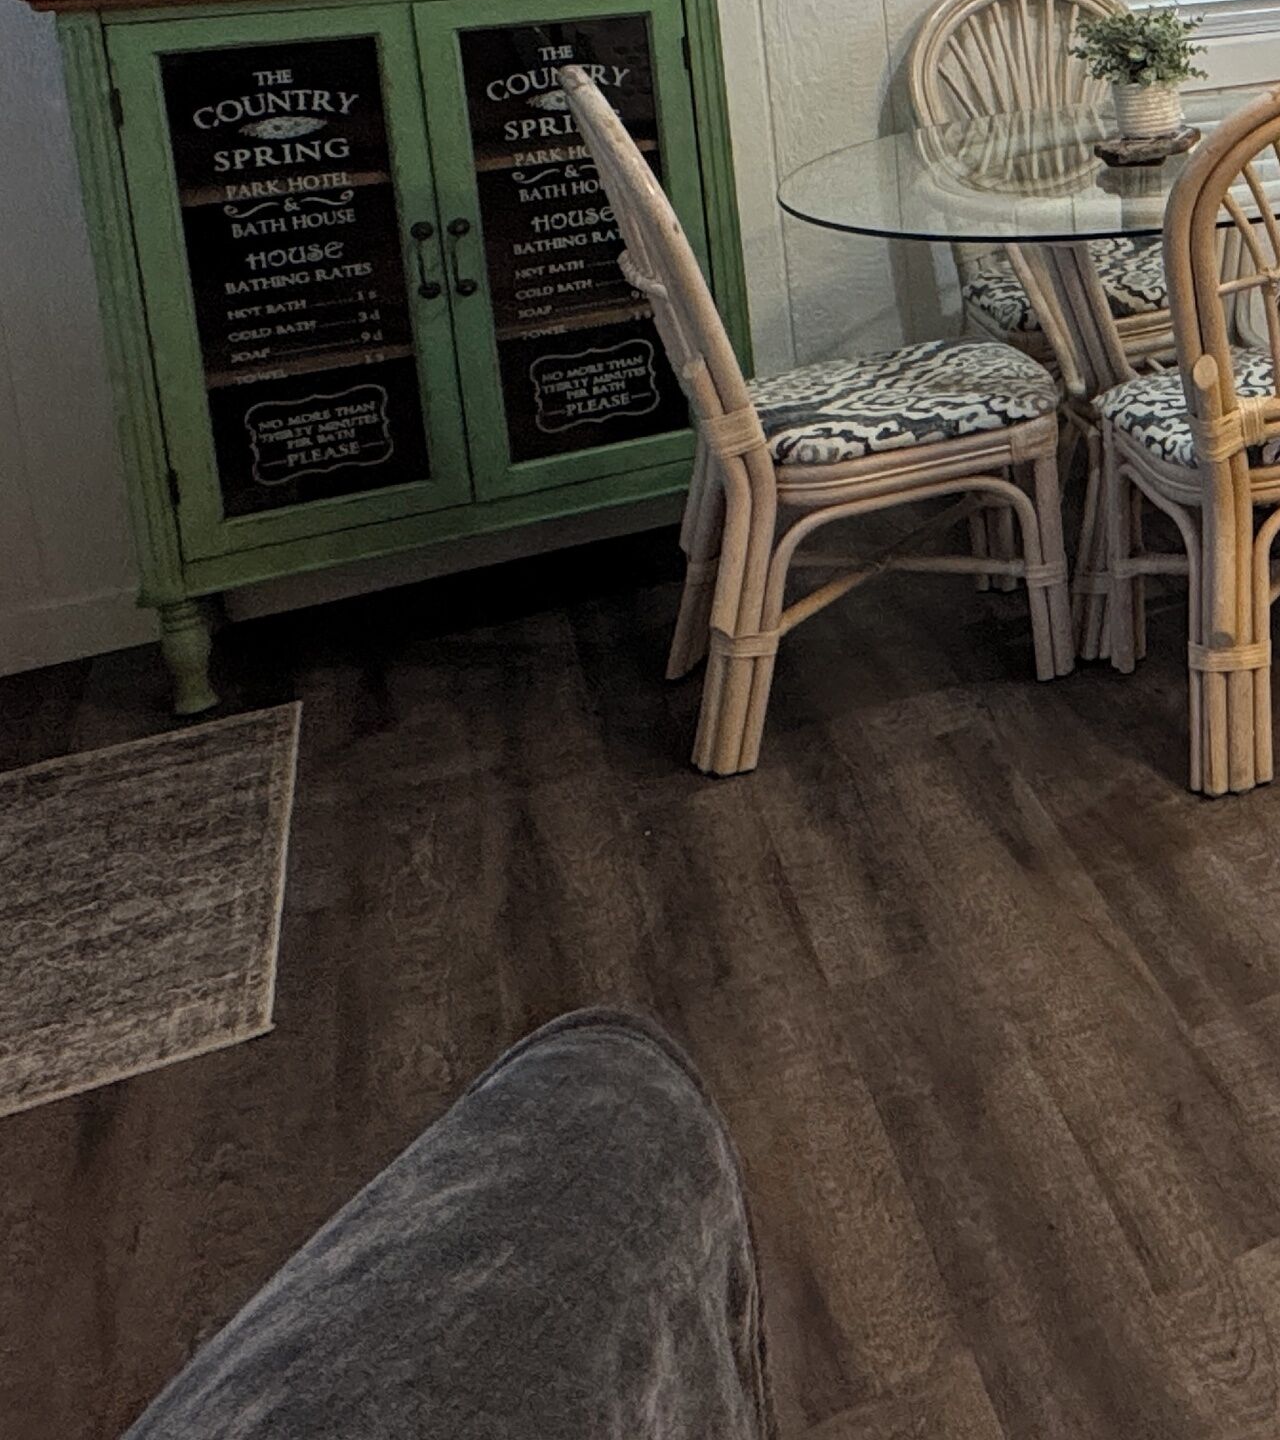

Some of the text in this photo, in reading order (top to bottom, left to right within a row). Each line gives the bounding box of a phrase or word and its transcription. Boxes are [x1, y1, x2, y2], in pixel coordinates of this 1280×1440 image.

[538, 45, 574, 61] THE
[252, 69, 294, 86] THE
[193, 89, 359, 129] COUNTRY
[213, 138, 351, 172] SPRING
[514, 147, 564, 167] PARK
[564, 164, 580, 178] &
[225, 172, 352, 201] PARK HOTEL
[518, 184, 567, 202] BATH
[284, 197, 301, 212] &
[231, 209, 356, 238] BATH HOUSE
[245, 241, 345, 270] HOUSE
[513, 233, 588, 256] BATHING
[224, 262, 373, 295] BATHING RATES
[565, 392, 631, 417] PLEASE
[287, 441, 361, 467] PLEASE
